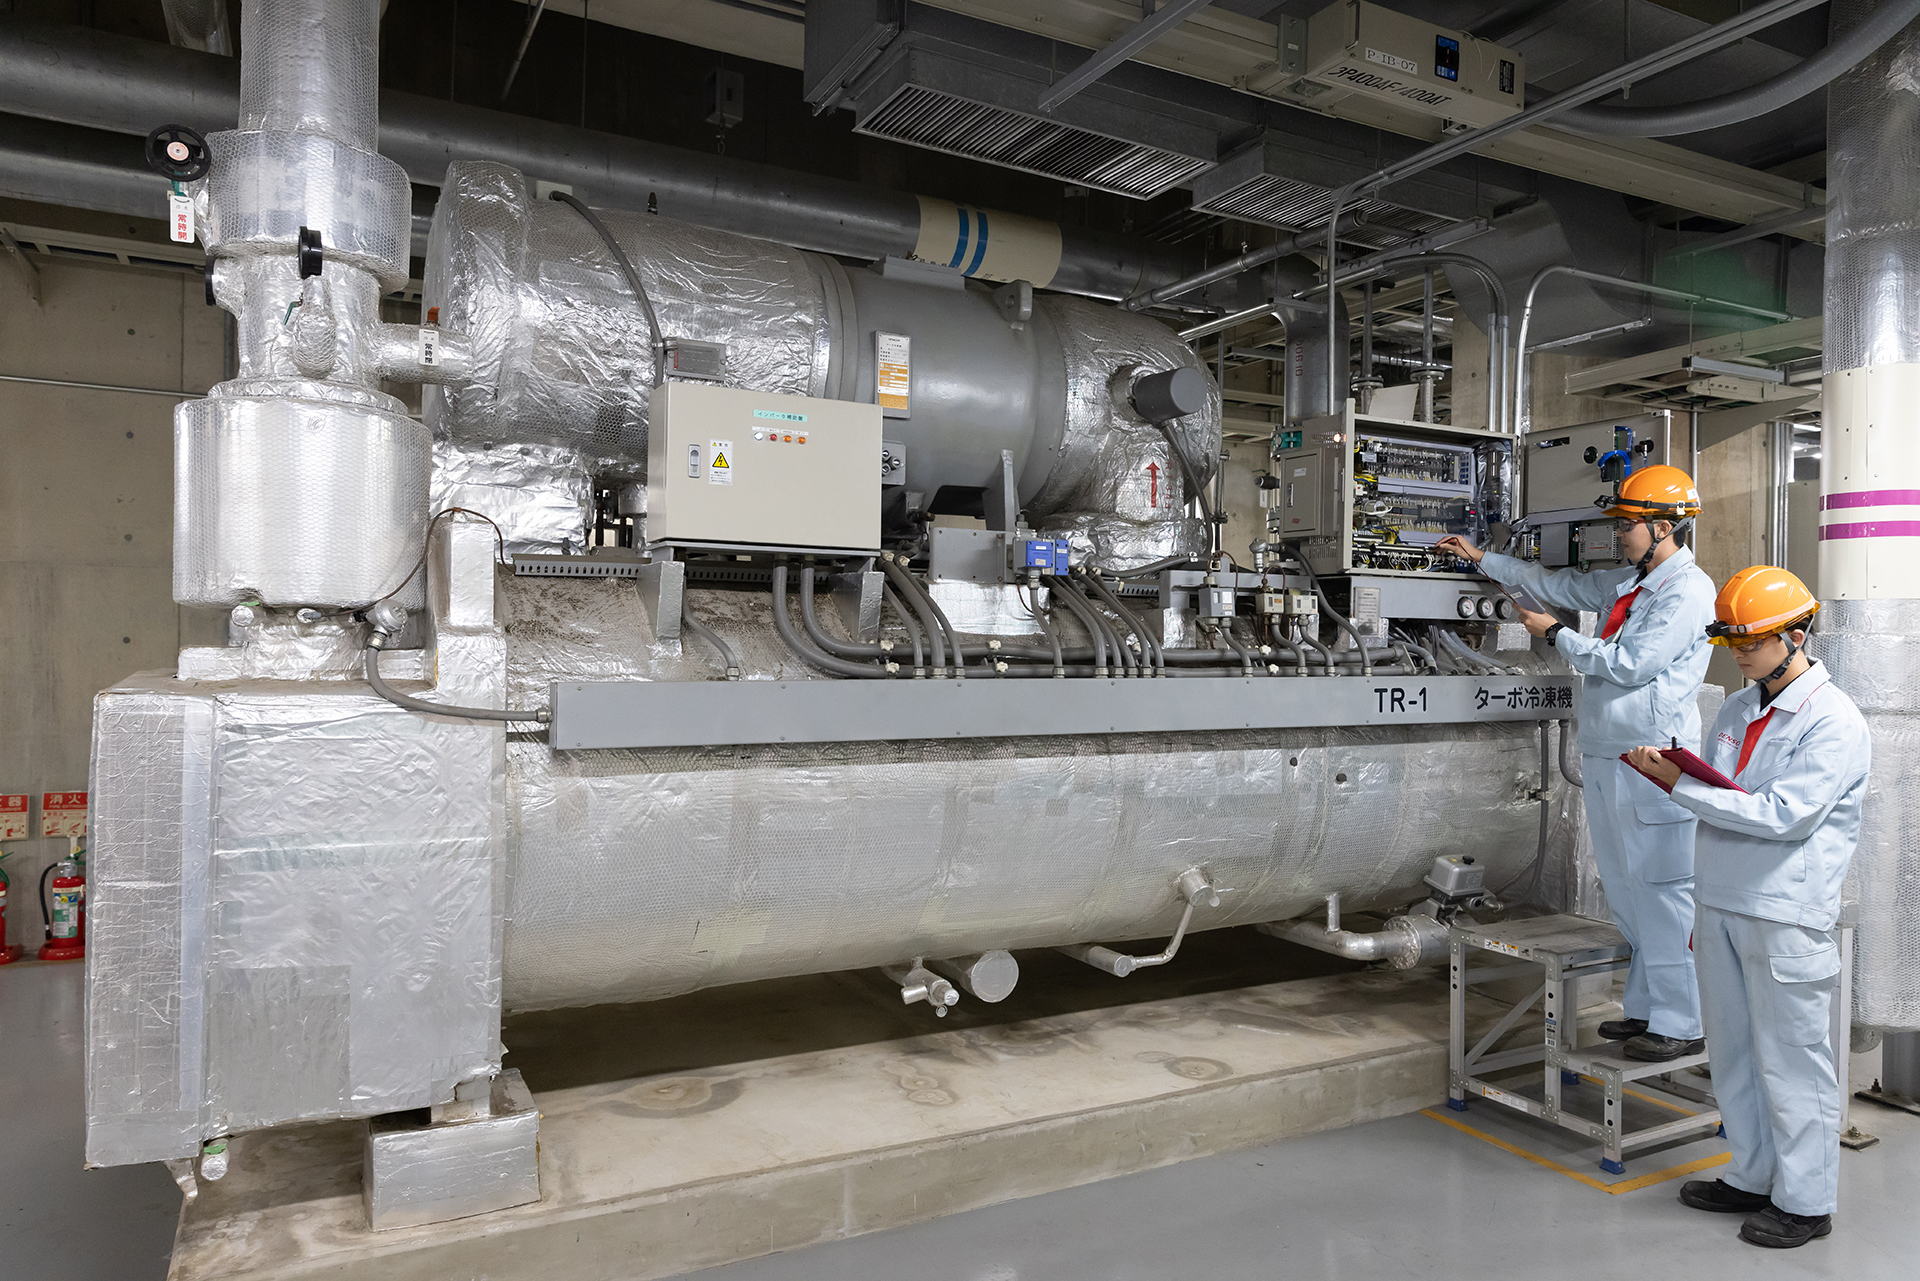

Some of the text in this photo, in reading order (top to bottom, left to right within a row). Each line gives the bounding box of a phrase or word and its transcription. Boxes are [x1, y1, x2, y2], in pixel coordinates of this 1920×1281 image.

[1373, 686, 1573, 713] TR-1 ターボ冷凍機
[1718, 731, 1742, 747] DENSO
[49, 794, 82, 804] 消火
